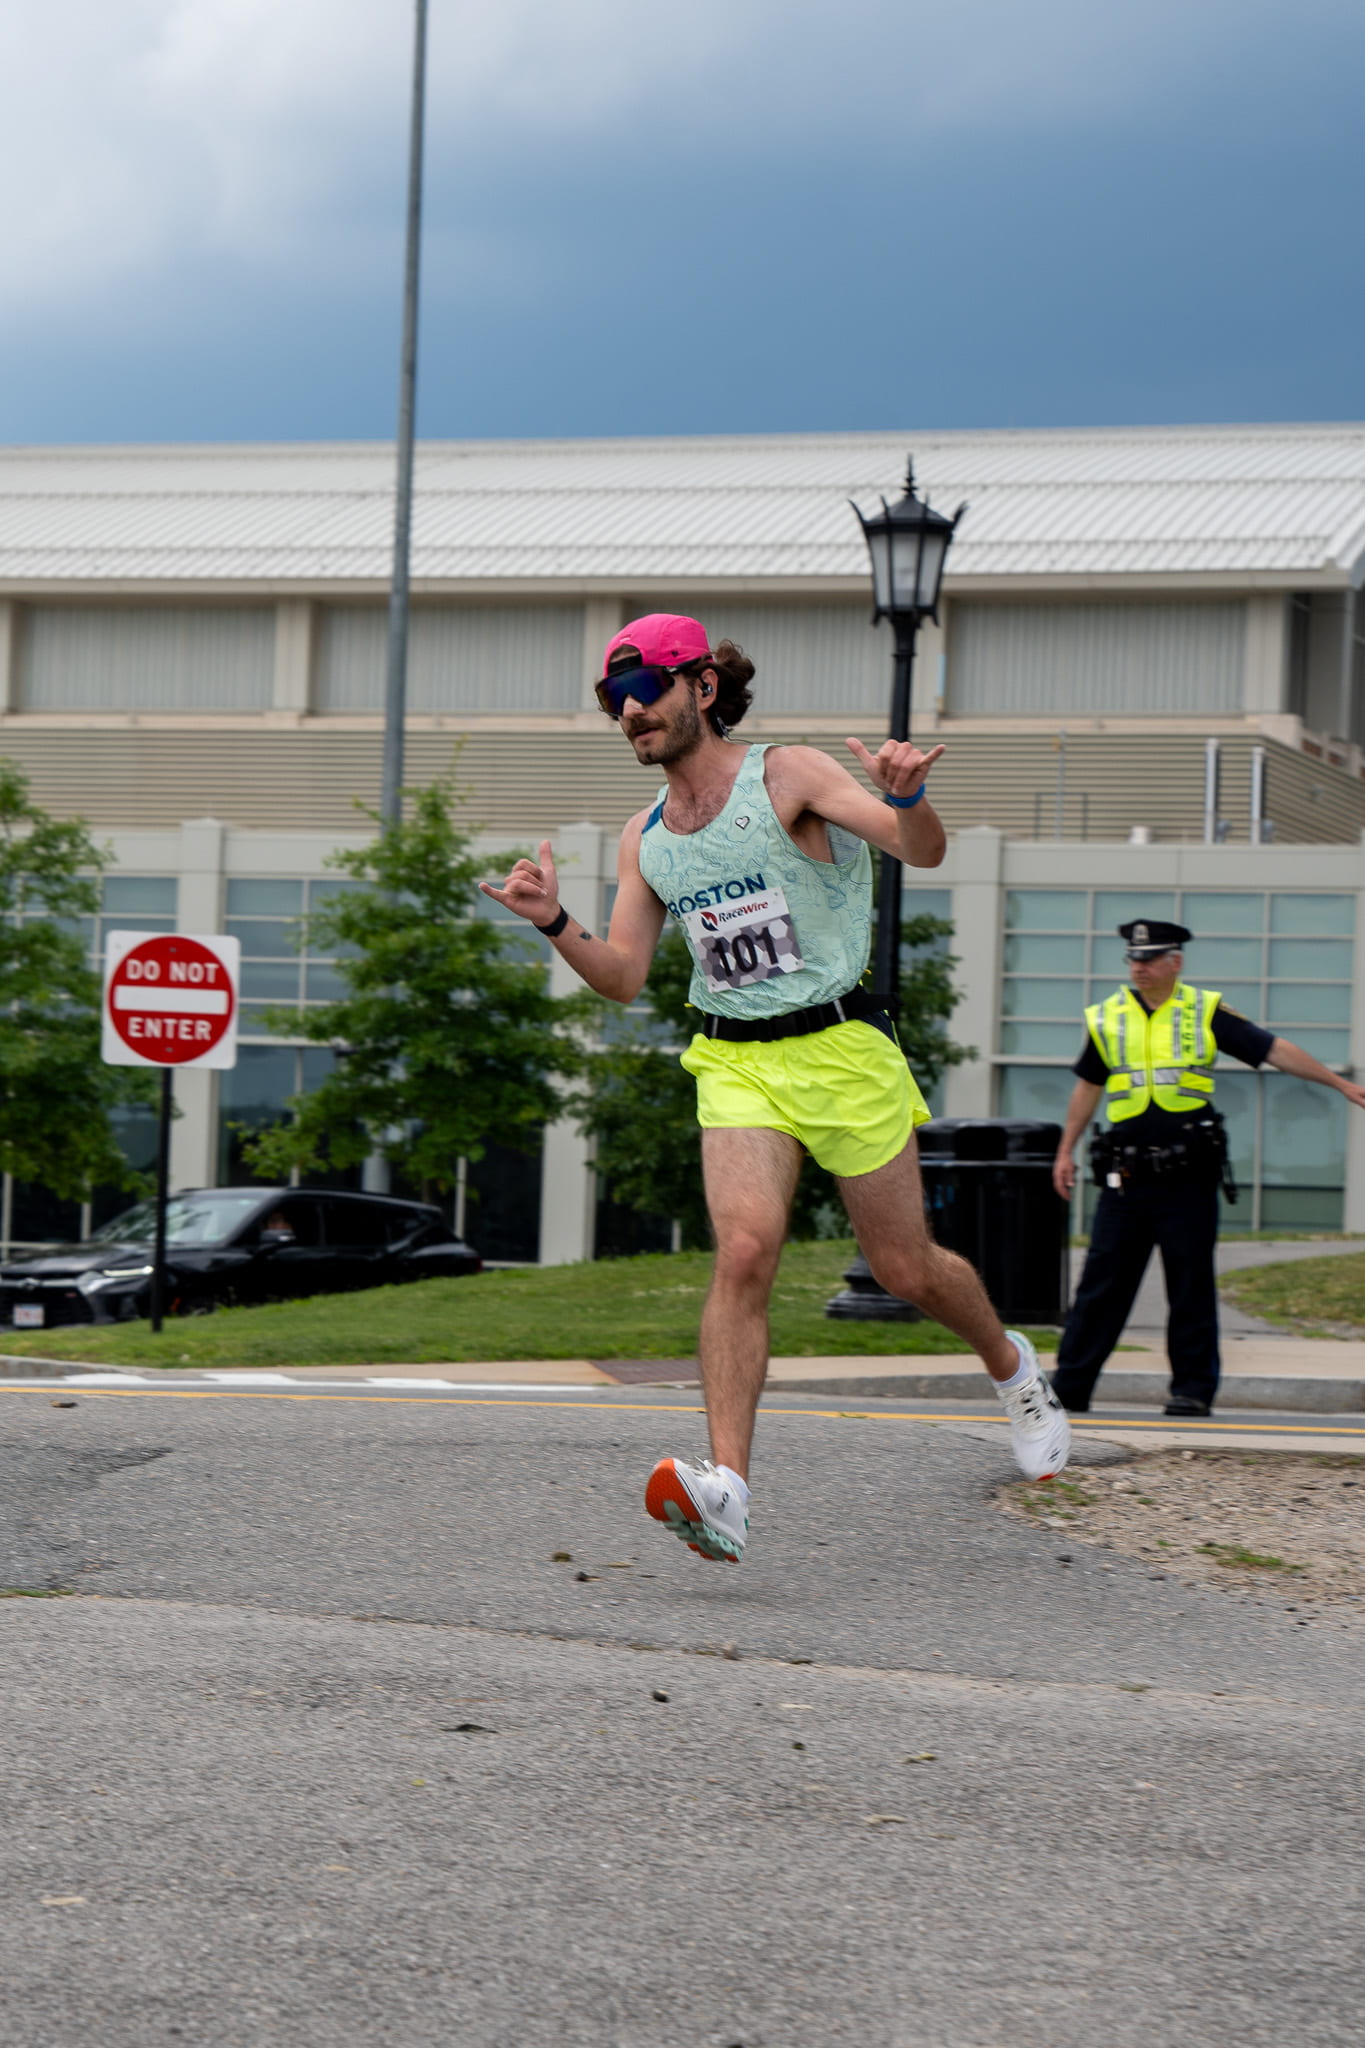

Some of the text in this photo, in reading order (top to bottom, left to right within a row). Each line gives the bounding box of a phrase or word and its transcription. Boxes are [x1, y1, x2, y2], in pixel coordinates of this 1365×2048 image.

[668, 873, 767, 919] BOSTON
[719, 901, 769, 922] RaceWire
[712, 926, 779, 977] 101
[126, 959, 219, 984] DO NOT
[128, 1016, 212, 1041] ENTER
